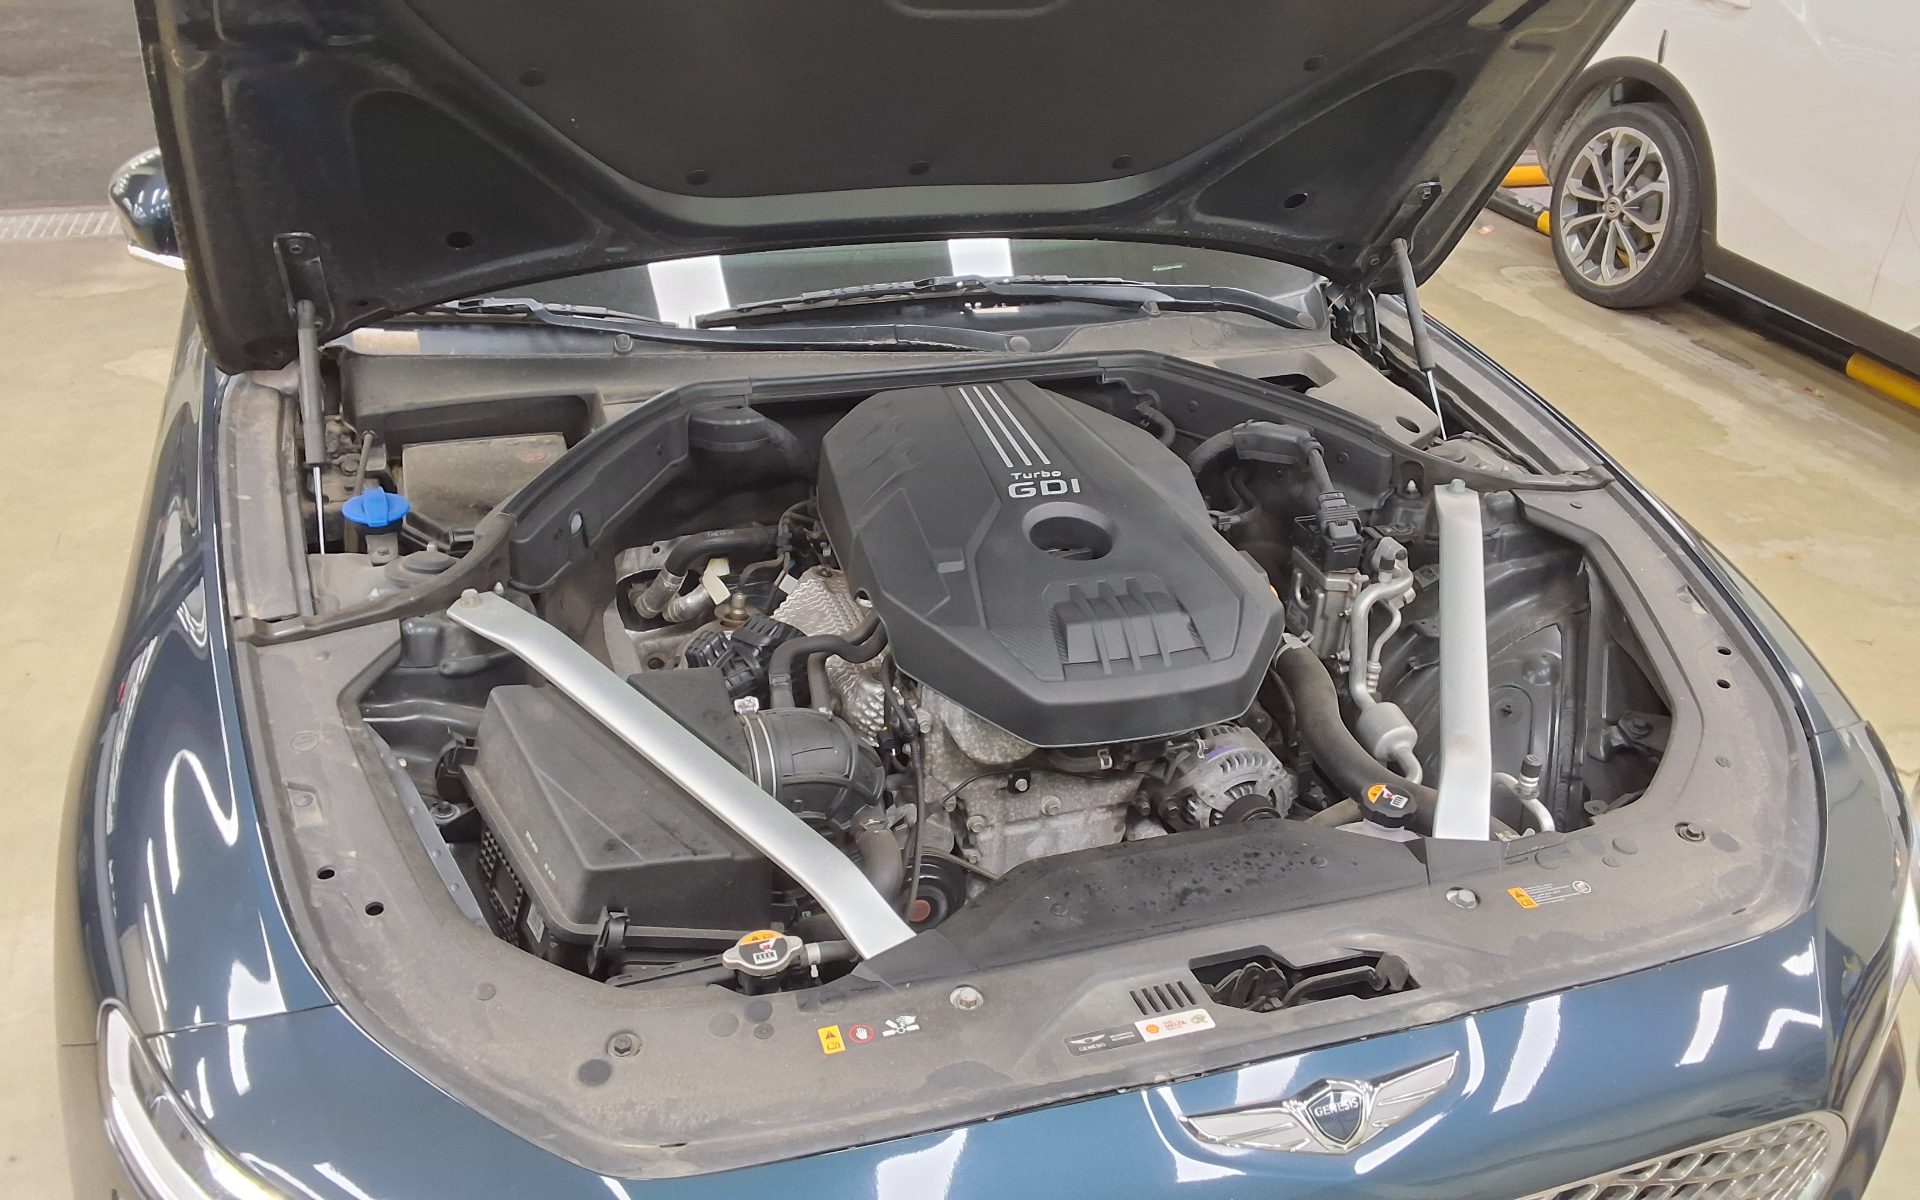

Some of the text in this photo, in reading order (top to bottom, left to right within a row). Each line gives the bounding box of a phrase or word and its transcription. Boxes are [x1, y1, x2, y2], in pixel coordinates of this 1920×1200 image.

[1010, 470, 1062, 480] Turbo
[1008, 478, 1080, 498] GDI
[1314, 1097, 1359, 1117] GENESIS
